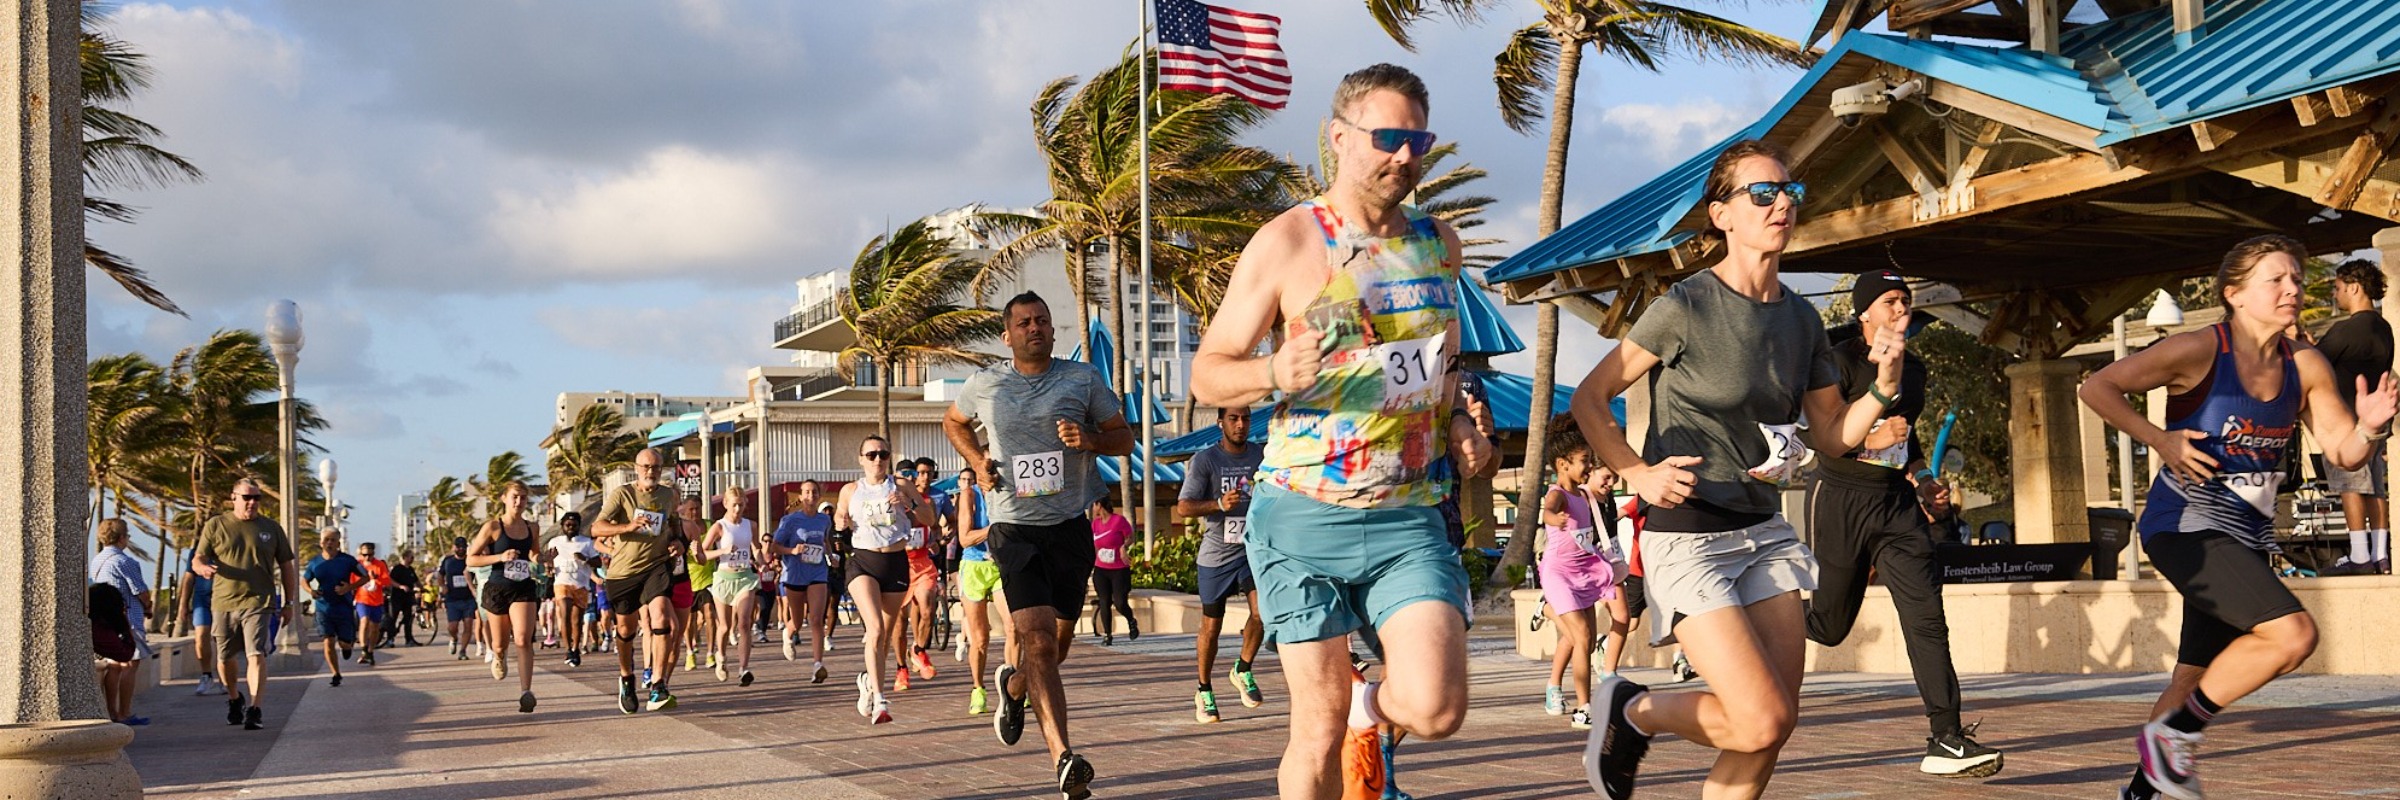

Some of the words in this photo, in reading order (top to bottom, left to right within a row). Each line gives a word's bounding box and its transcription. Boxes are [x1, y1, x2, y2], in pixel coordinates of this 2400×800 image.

[2240, 435, 2289, 449] DEPOT
[676, 463, 701, 478] NO
[1018, 457, 1060, 479] 283
[1221, 476, 1239, 494] 5K
[864, 500, 893, 517] 312
[1228, 520, 1247, 534] 27
[729, 550, 749, 562] 279
[803, 545, 823, 557] 277
[507, 560, 530, 574] 292
[1944, 562, 2000, 577] Fenstersheib
[2003, 561, 2021, 574] Law
[2025, 560, 2054, 573] Group
